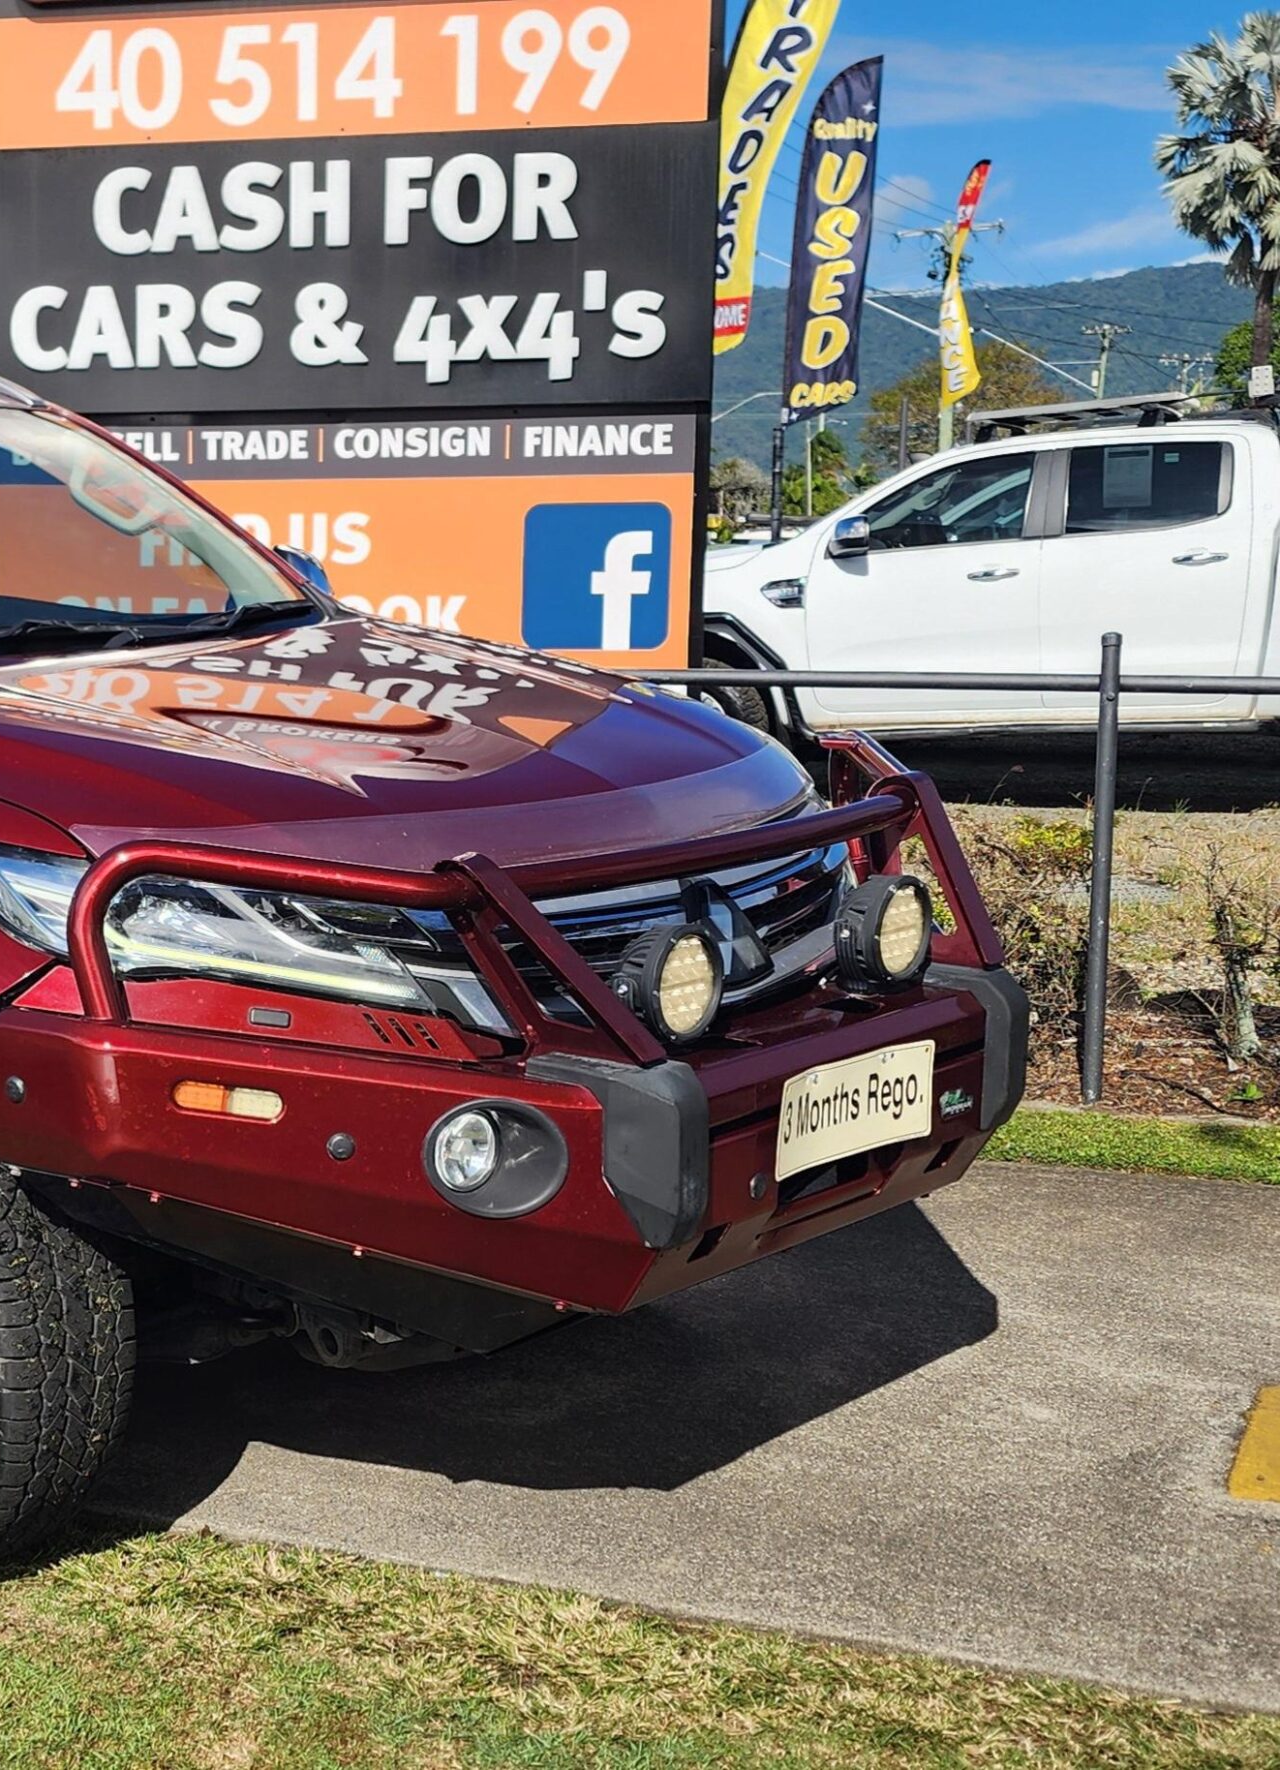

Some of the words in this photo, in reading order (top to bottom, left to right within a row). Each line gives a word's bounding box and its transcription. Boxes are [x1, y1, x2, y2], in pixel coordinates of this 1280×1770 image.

[55, 28, 182, 131] 40
[208, 16, 403, 127] 514
[439, 6, 631, 115] 199
[93, 159, 351, 256] CASH
[384, 151, 579, 246] FOR
[801, 150, 868, 370] USED
[10, 281, 264, 372] CARS
[289, 282, 368, 365] &
[789, 380, 857, 408] CARS
[111, 431, 180, 462] ELL
[201, 430, 309, 461] TRADE
[333, 426, 491, 460] CONSIGN
[523, 424, 674, 457] FINANCE
[288, 512, 372, 565] US
[783, 1101, 793, 1144] 3
[796, 1082, 861, 1139] Months
[867, 1072, 924, 1121] Rego.
